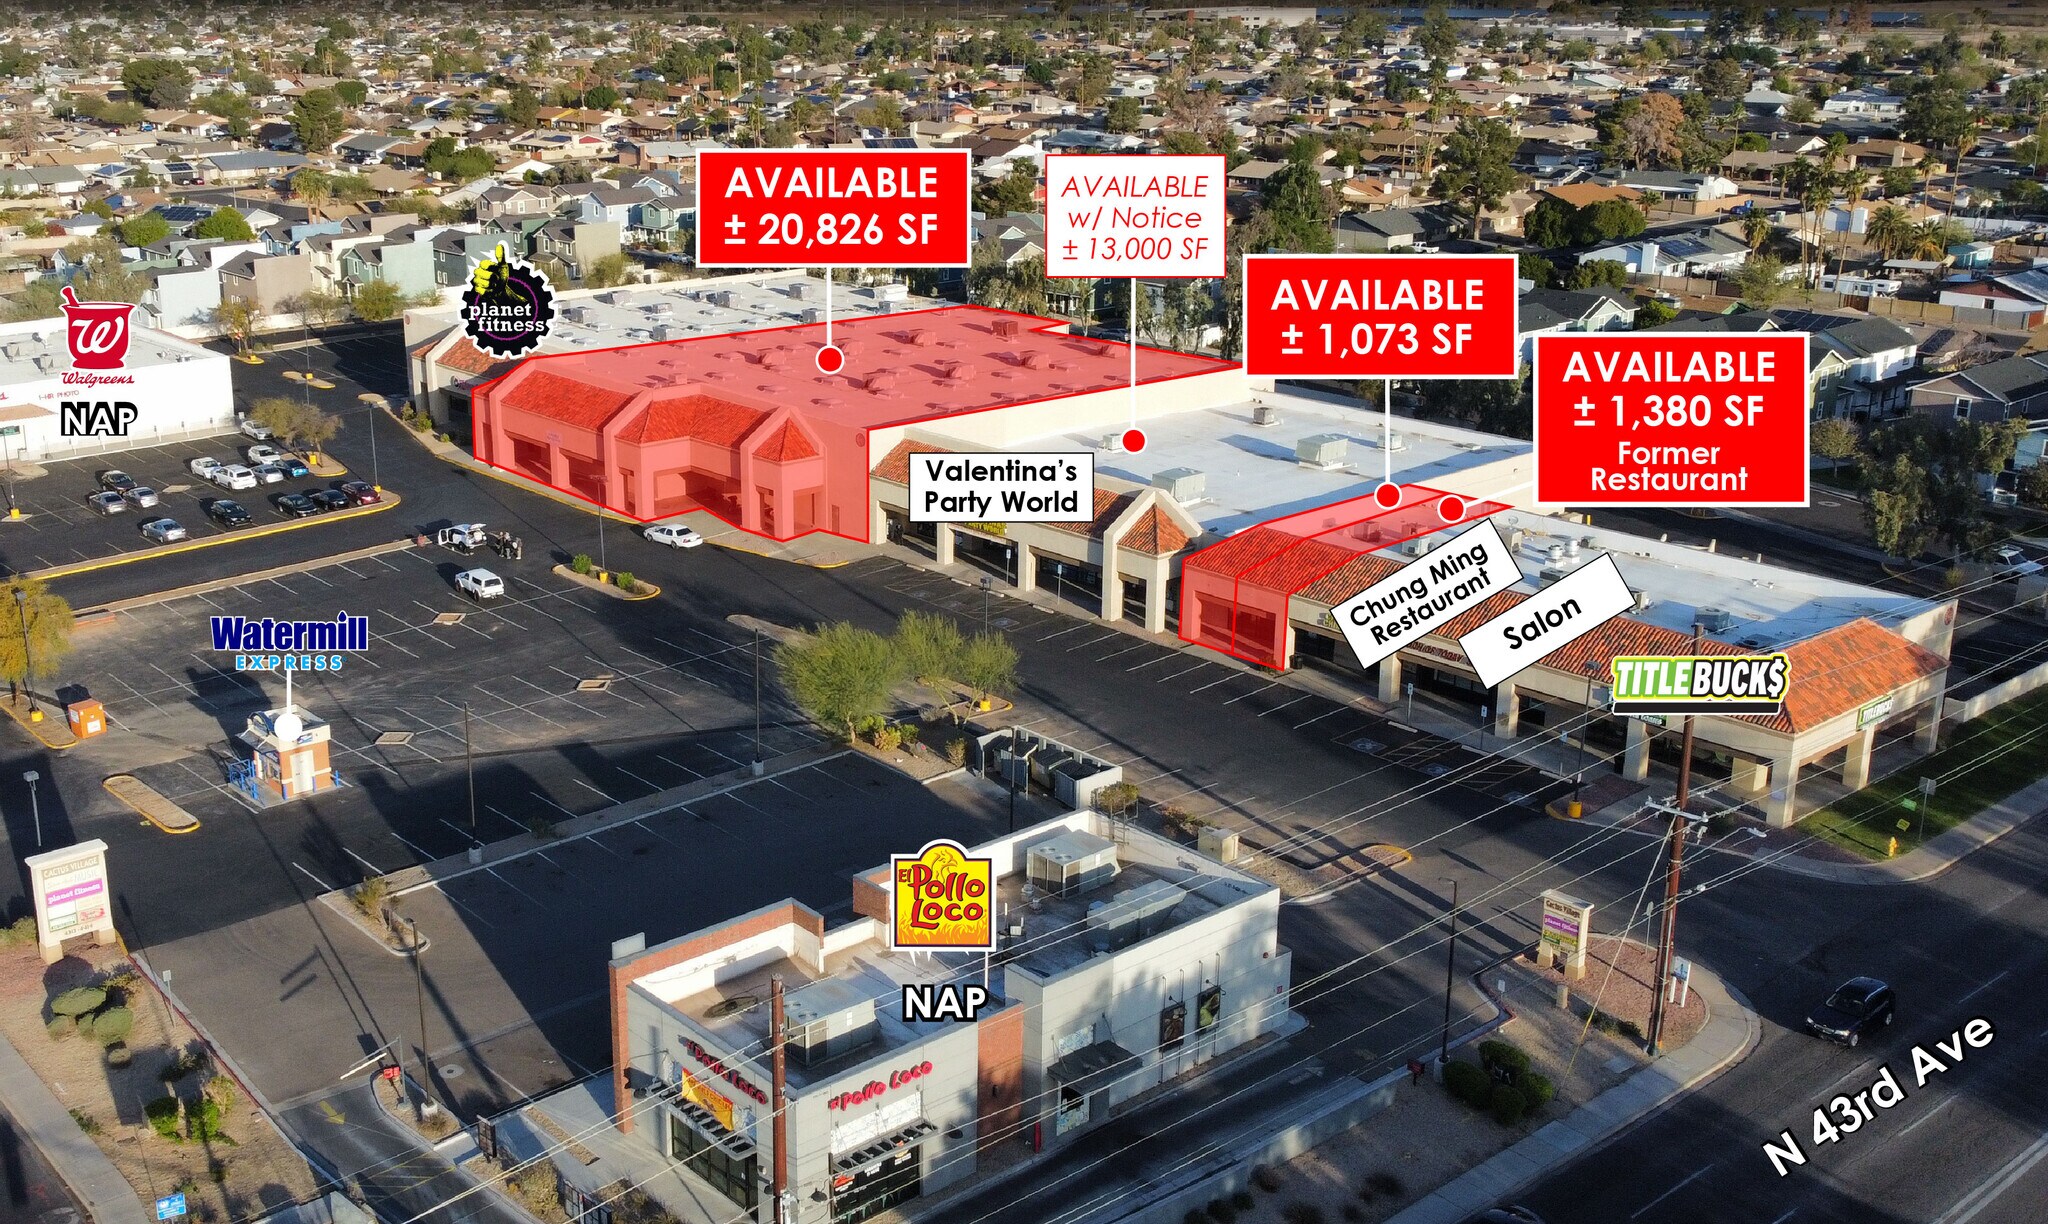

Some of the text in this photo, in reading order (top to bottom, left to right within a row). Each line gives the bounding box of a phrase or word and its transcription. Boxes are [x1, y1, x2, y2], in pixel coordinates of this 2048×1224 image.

[43, 856, 98, 878] CACTUS VILLAGE
[840, 1080, 887, 1112] Pollo
[889, 1060, 934, 1090] Loco
